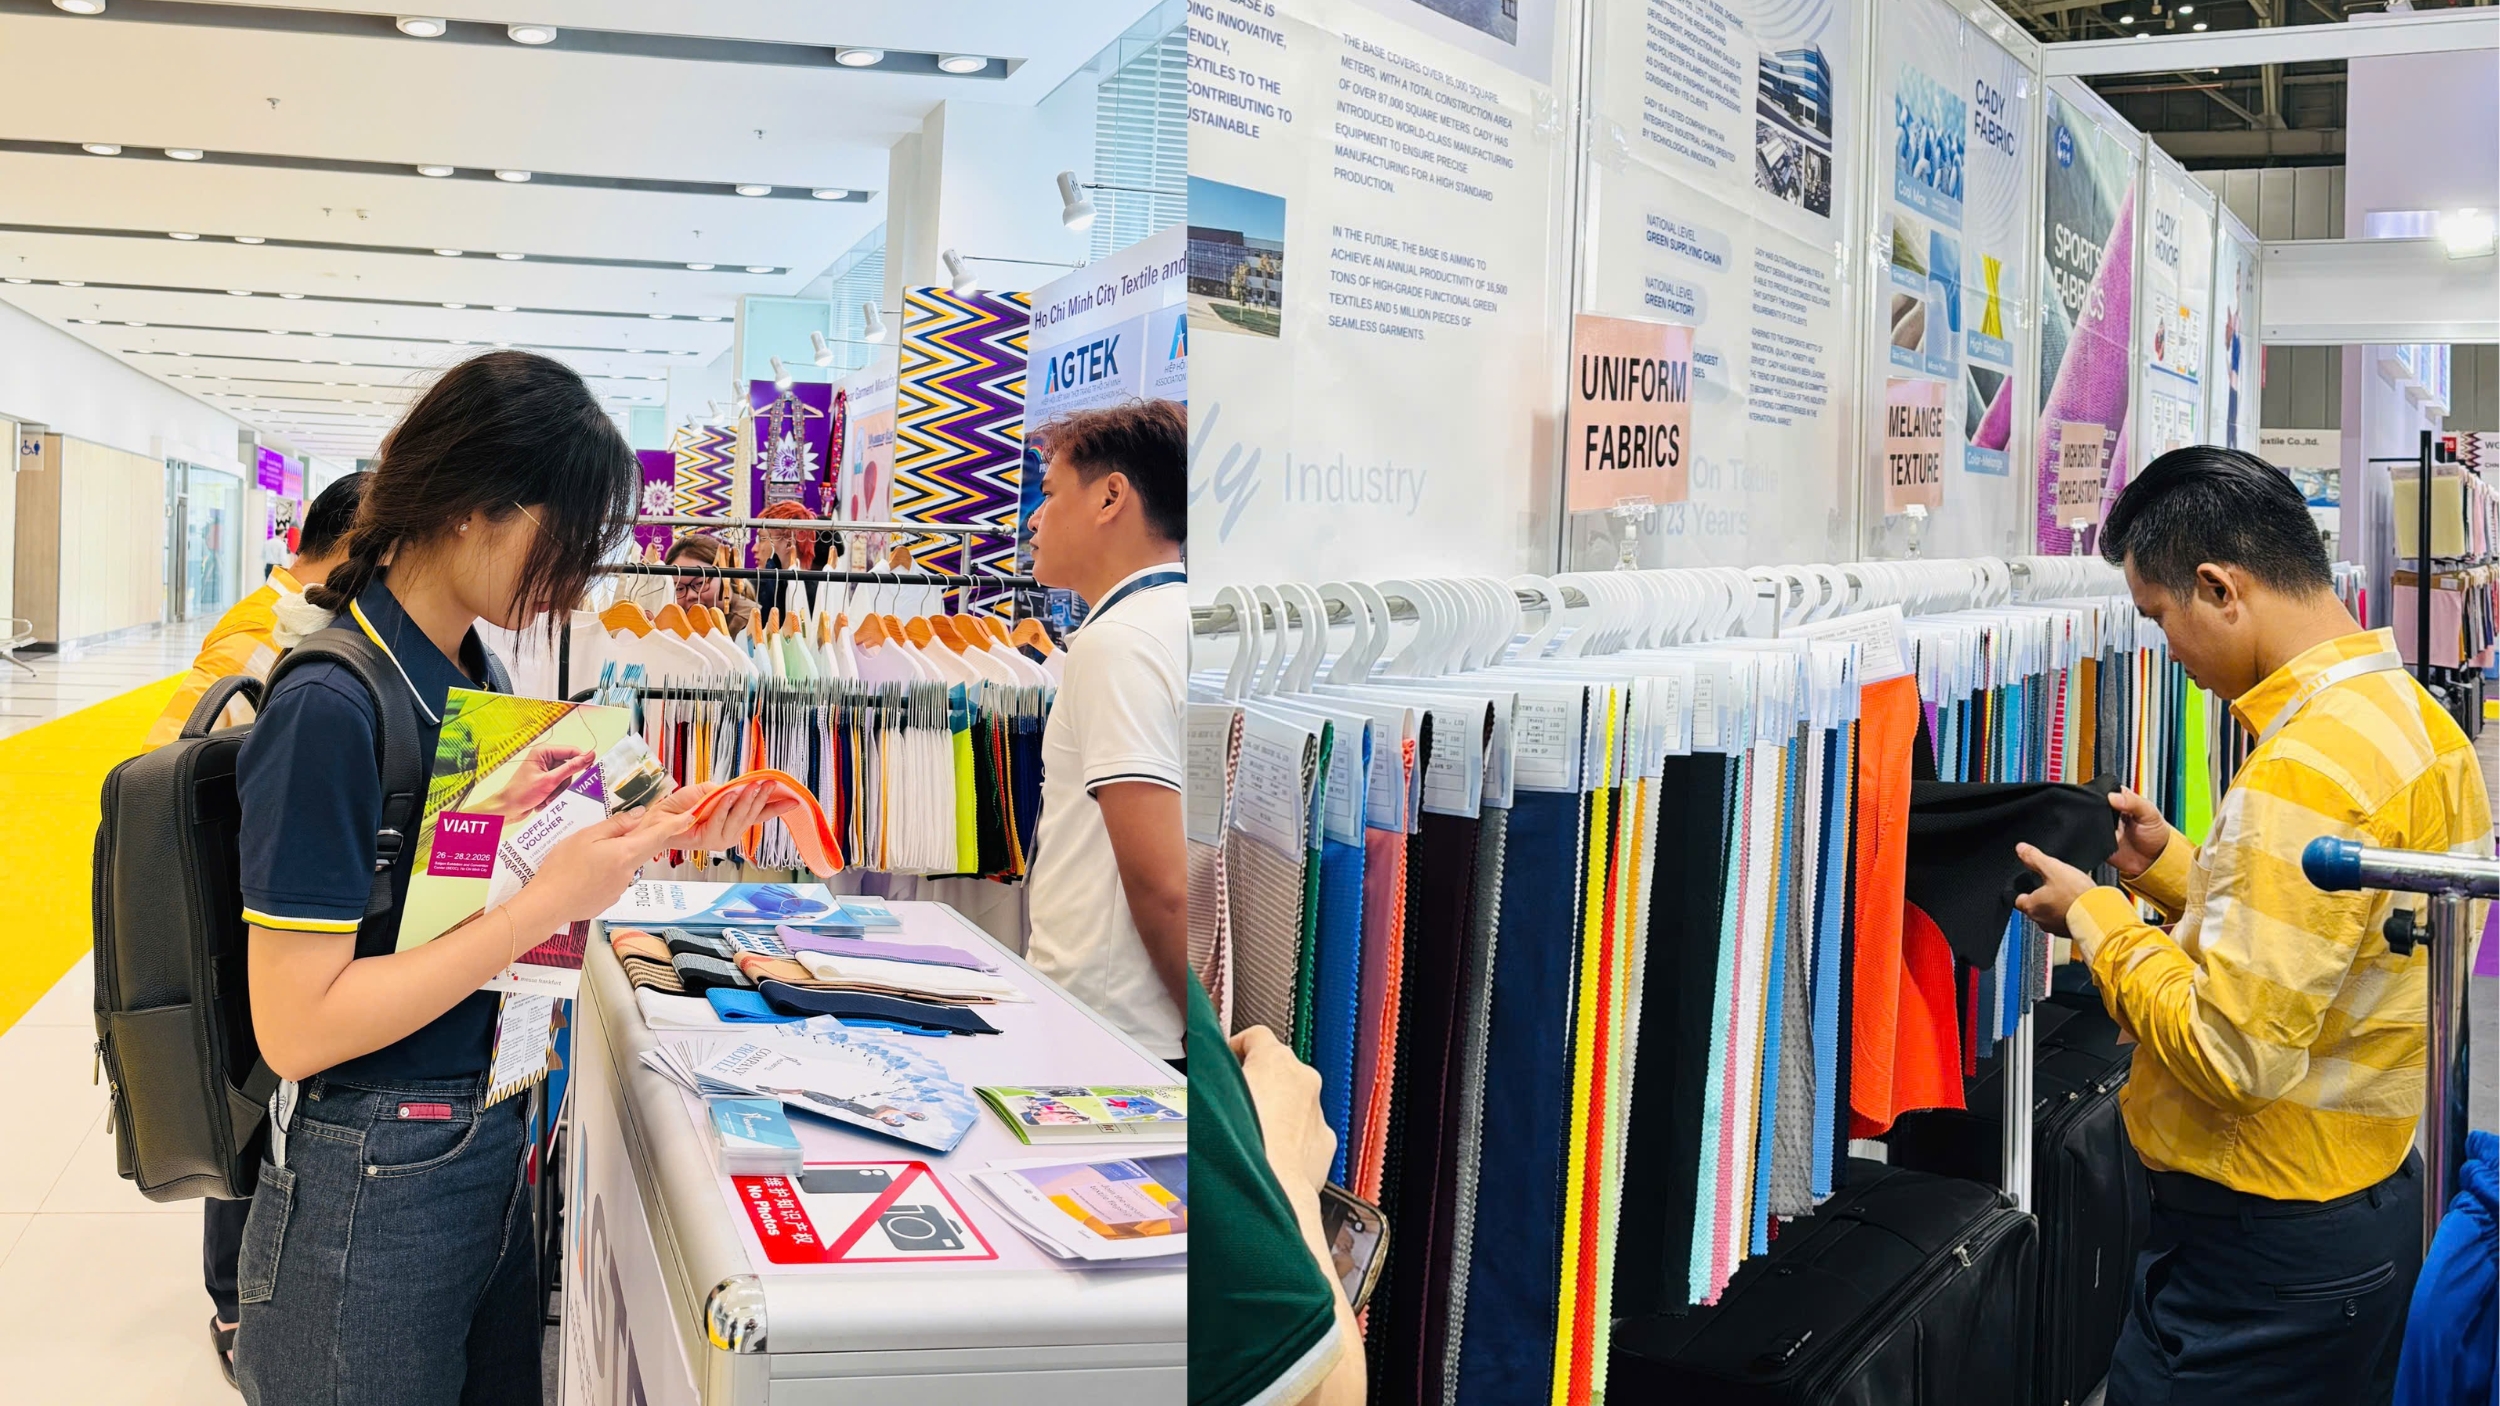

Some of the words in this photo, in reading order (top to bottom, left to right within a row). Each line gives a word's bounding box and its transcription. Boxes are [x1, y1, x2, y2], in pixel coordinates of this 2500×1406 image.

[1264, 2, 1275, 17] IS
[1217, 11, 1286, 50] INNOVATIVE,
[1239, 70, 1255, 86] TO
[1258, 76, 1281, 95] THE
[1341, 55, 1377, 80] METERS,
[1379, 70, 1400, 88] WITH
[1410, 81, 1433, 100] TOTAL
[1435, 91, 1493, 122] CONSTRUCTION
[1494, 112, 1513, 130] AREA
[1975, 79, 2006, 120] CADY
[1278, 108, 1292, 123] TO
[1339, 77, 1351, 93] OF
[1352, 82, 1376, 102] OVER
[1405, 101, 1438, 123] SQUARE
[1473, 125, 1493, 142] CADY
[1494, 133, 1508, 148] HAS
[1335, 122, 1389, 150] EQUIPMENT
[1390, 139, 1400, 153] TO
[1402, 143, 1435, 164] ENSURE
[1436, 154, 1468, 174] PRECISE
[1336, 100, 1394, 130] INTRODUCED
[1396, 120, 1452, 149] WORLD-CLASS
[1453, 139, 1513, 169] MANUFACTURING
[1974, 110, 2015, 157] FABRIC
[1334, 145, 1410, 178] MANUFACTURING
[1412, 167, 1428, 183] FOR
[1429, 173, 1434, 185] A
[1436, 175, 1454, 190] HIGH
[1455, 180, 1493, 202] STANDARD
[1334, 167, 1395, 193] PRODUCTION.
[1647, 214, 1676, 235] NATIONAL
[1678, 225, 1696, 242] LEVEL
[2156, 208, 2176, 237] CADY
[1332, 225, 1341, 238] IN
[1344, 228, 1362, 243] THE
[1402, 241, 1417, 255] THE
[1419, 245, 1439, 260] BASE
[1441, 250, 1448, 262] IS
[1450, 252, 1475, 268] AIMING
[1477, 258, 1486, 271] TO
[1646, 230, 1668, 247] GREEN
[1670, 238, 1702, 259] SUPPLYING
[1704, 251, 1721, 266] CHAIN
[2055, 223, 2104, 277] SPORTS
[2155, 239, 2178, 270] HONOR
[1331, 248, 1372, 267] ACHIEVE
[1373, 257, 1385, 270] AN
[1386, 259, 1418, 277] ANNUAL
[1420, 267, 1474, 288] PRODUCTIVITY
[1476, 278, 1486, 291] OF
[1035, 312, 1047, 330] Ho
[1050, 301, 1065, 324] Chi
[1068, 290, 1093, 318] Minh
[1096, 283, 1118, 306] City
[1121, 265, 1158, 298] Textile
[1162, 251, 1187, 281] and
[1330, 270, 1356, 286] TONS
[1358, 275, 1371, 289] OF
[1373, 278, 1423, 298] HIGH-GRADE
[1425, 288, 1472, 308] FUNCTIONAL
[1473, 298, 1497, 313] GREEN
[1645, 276, 1675, 296] NATIONAL
[1676, 286, 1694, 301] LEVEL
[1645, 293, 1666, 309] GREEN
[1668, 299, 1695, 317] FACTORY
[2053, 267, 2105, 322] FABRICS
[1328, 315, 1377, 333] SEAMLESS
[1329, 292, 1372, 311] TEXTILES
[1374, 300, 1392, 314] AND
[1393, 303, 1398, 315] 5
[1400, 305, 1431, 321] MILLION
[1433, 310, 1460, 325] PIECES
[1462, 315, 1472, 327] OF
[1044, 333, 1120, 395] AGTEK
[1155, 373, 1186, 387] ASSOCIATION
[1582, 354, 1687, 403] UNIFORM
[1889, 405, 1942, 438] MELANGE
[1585, 424, 1680, 471] FABRICS
[2064, 444, 2077, 468] HIGH
[2077, 444, 2099, 468] DENSITY
[1285, 452, 1428, 517] Industry
[1693, 455, 1720, 490] On
[1889, 453, 1939, 486] TEXTURE
[2059, 480, 2071, 505] HIGH
[2072, 480, 2098, 504] ELASTICITY
[1666, 504, 1685, 535] 23
[1692, 502, 1748, 536] Years
[2297, 673, 2330, 702] VIATT
[575, 773, 599, 794] VIATT
[443, 819, 489, 834] VIATT
[517, 819, 544, 844] COFFE
[550, 801, 568, 815] TEA
[522, 816, 564, 851] VOUCHER
[454, 853, 490, 861] 28.2.2026
[635, 884, 650, 906] PROFILE
[653, 884, 665, 904] COMPANY
[539, 978, 561, 986] frankfurt
[711, 1043, 758, 1073] PROFILE
[732, 1047, 772, 1076] COMPANY
[747, 1185, 762, 1198] No
[753, 1201, 780, 1236] Photos
[764, 1177, 814, 1244] 维护知识产权
